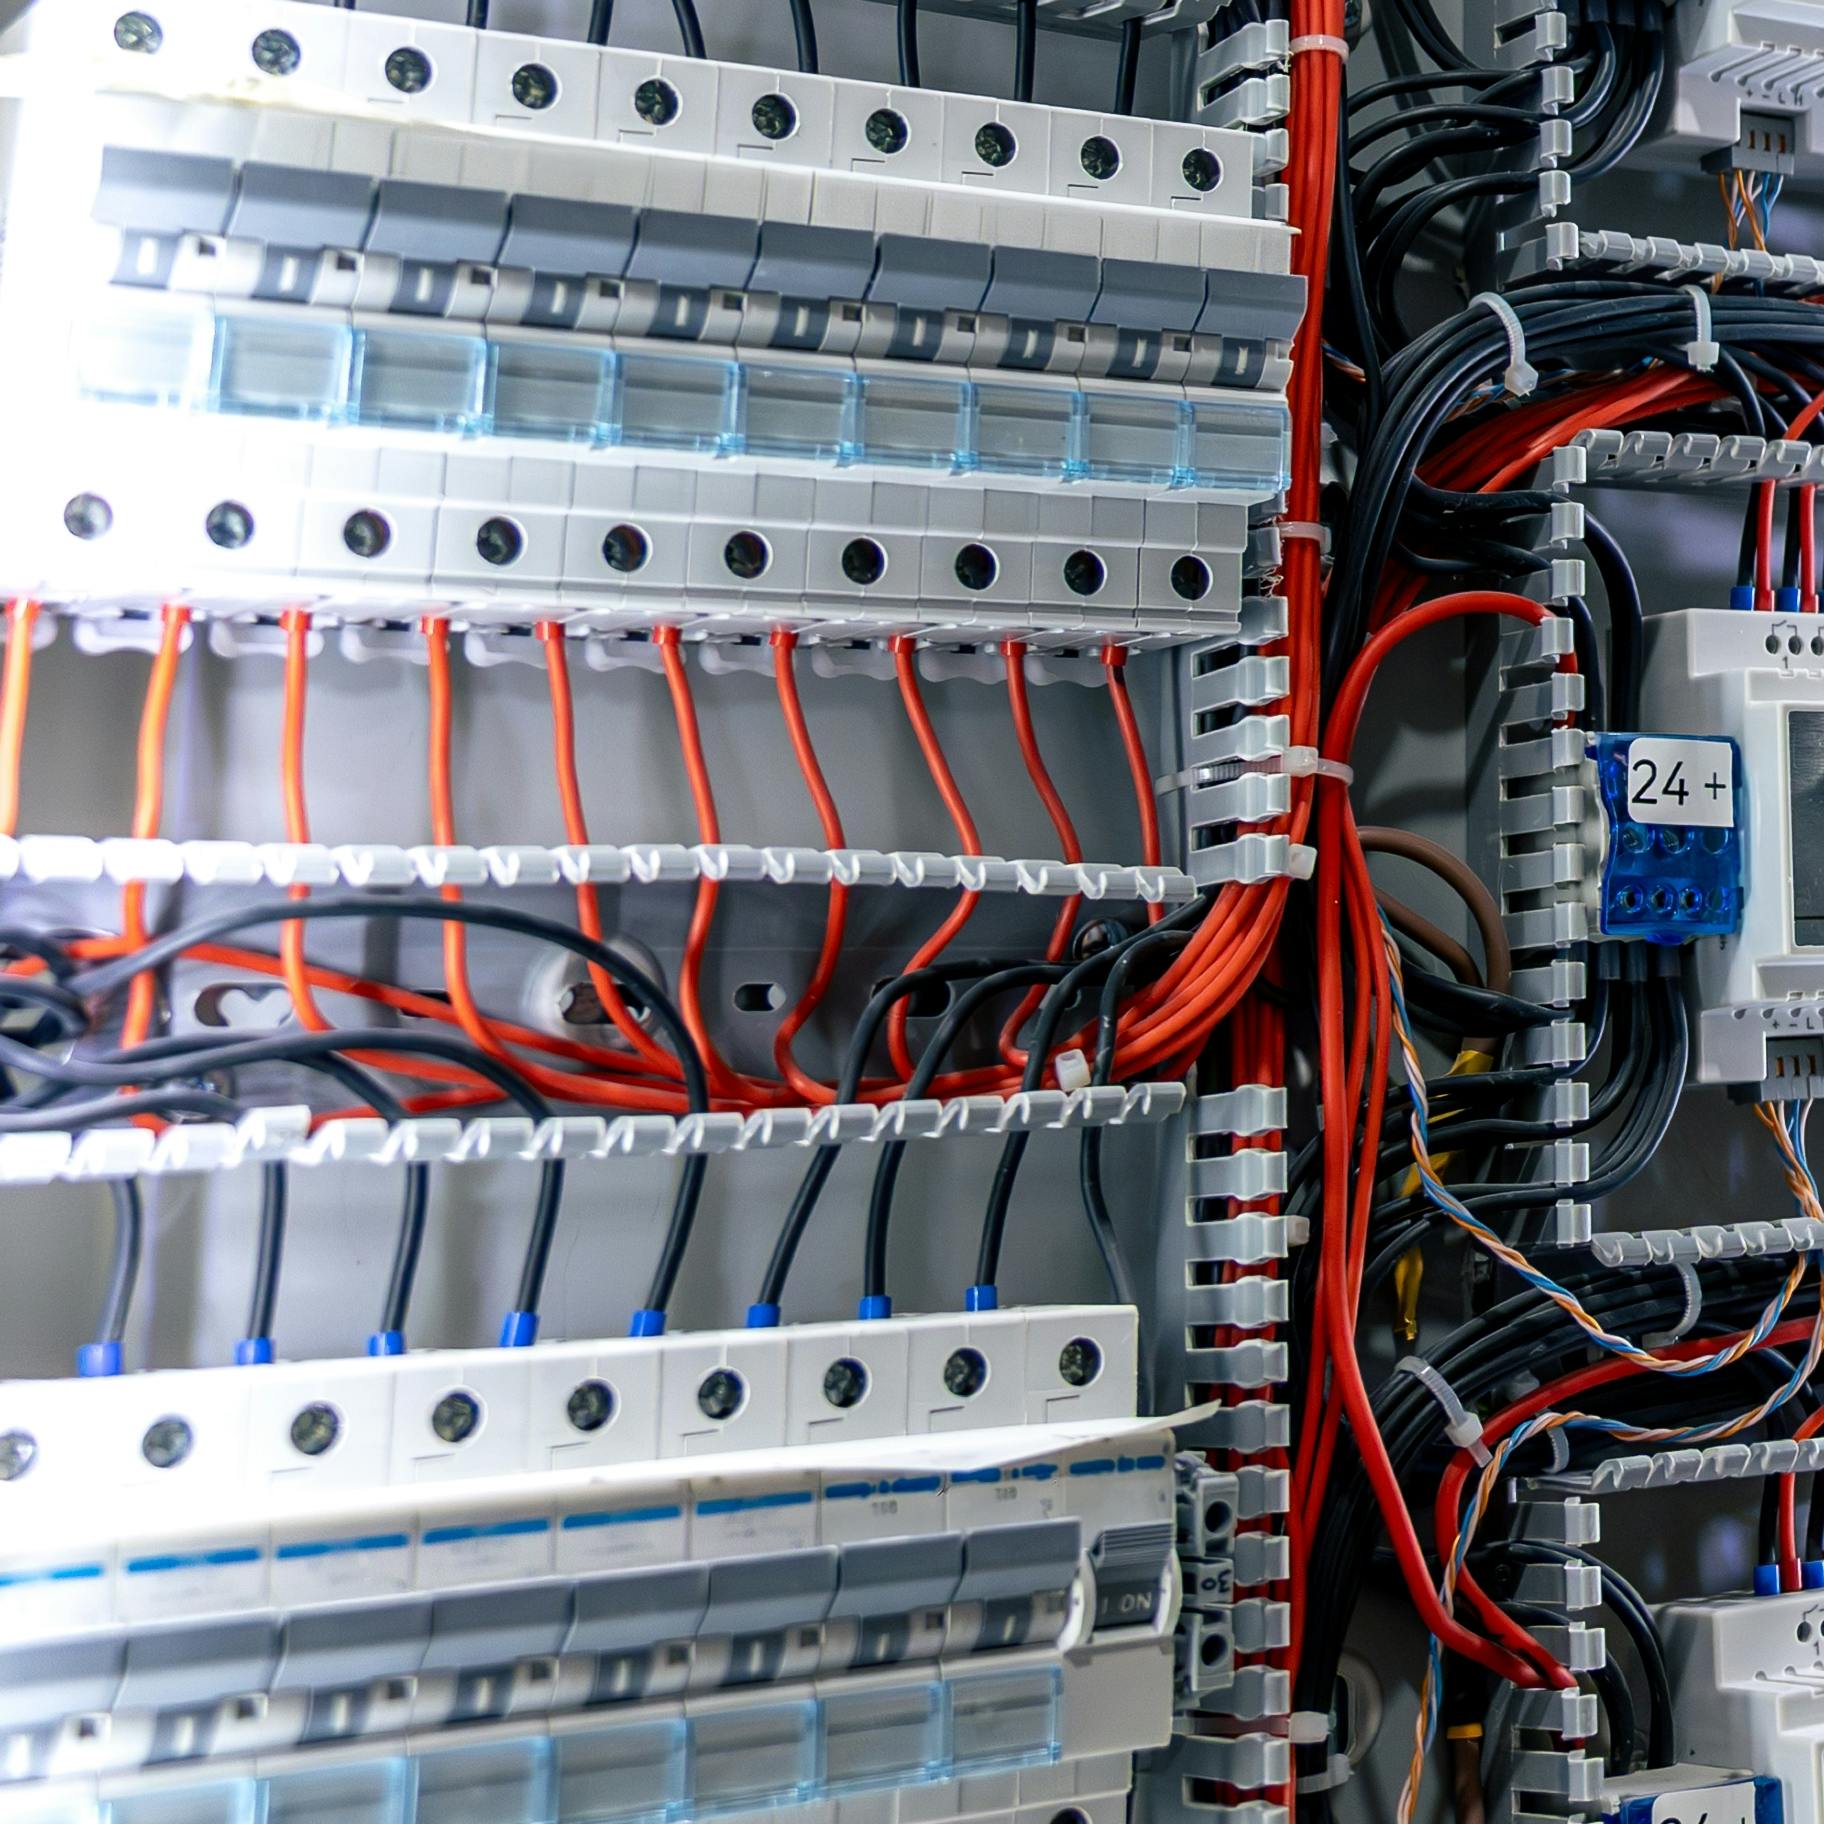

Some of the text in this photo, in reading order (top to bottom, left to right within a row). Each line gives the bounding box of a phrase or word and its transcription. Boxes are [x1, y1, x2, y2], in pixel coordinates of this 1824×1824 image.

[1782, 656, 1789, 670] 1
[1631, 758, 1690, 806] 24
[1806, 1017, 1815, 1030] L
[1119, 1591, 1152, 1613] ON
[1813, 1641, 1820, 1656] 1
